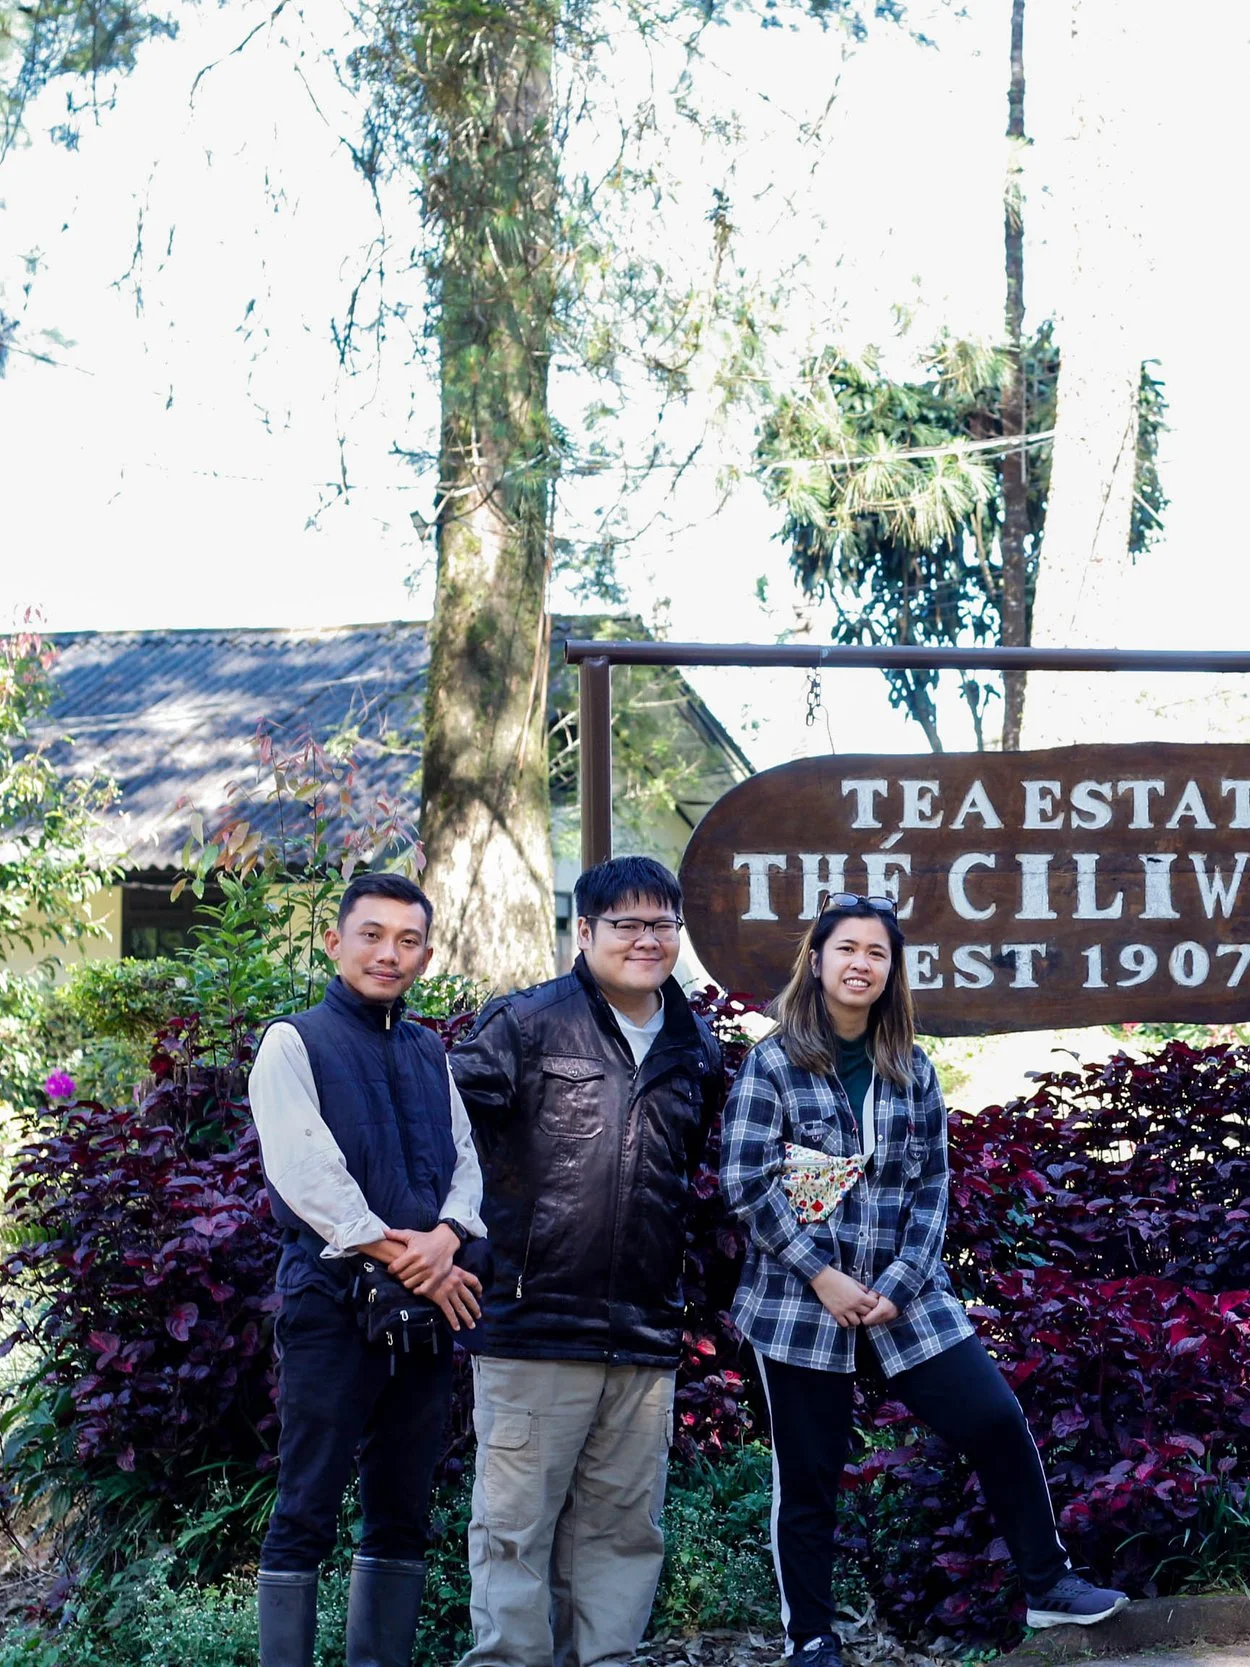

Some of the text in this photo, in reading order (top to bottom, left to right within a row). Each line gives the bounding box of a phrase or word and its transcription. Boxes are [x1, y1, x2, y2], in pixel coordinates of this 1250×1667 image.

[840, 779, 1004, 830] TEA
[732, 831, 915, 921] THÉ
[903, 943, 1047, 990] EST
